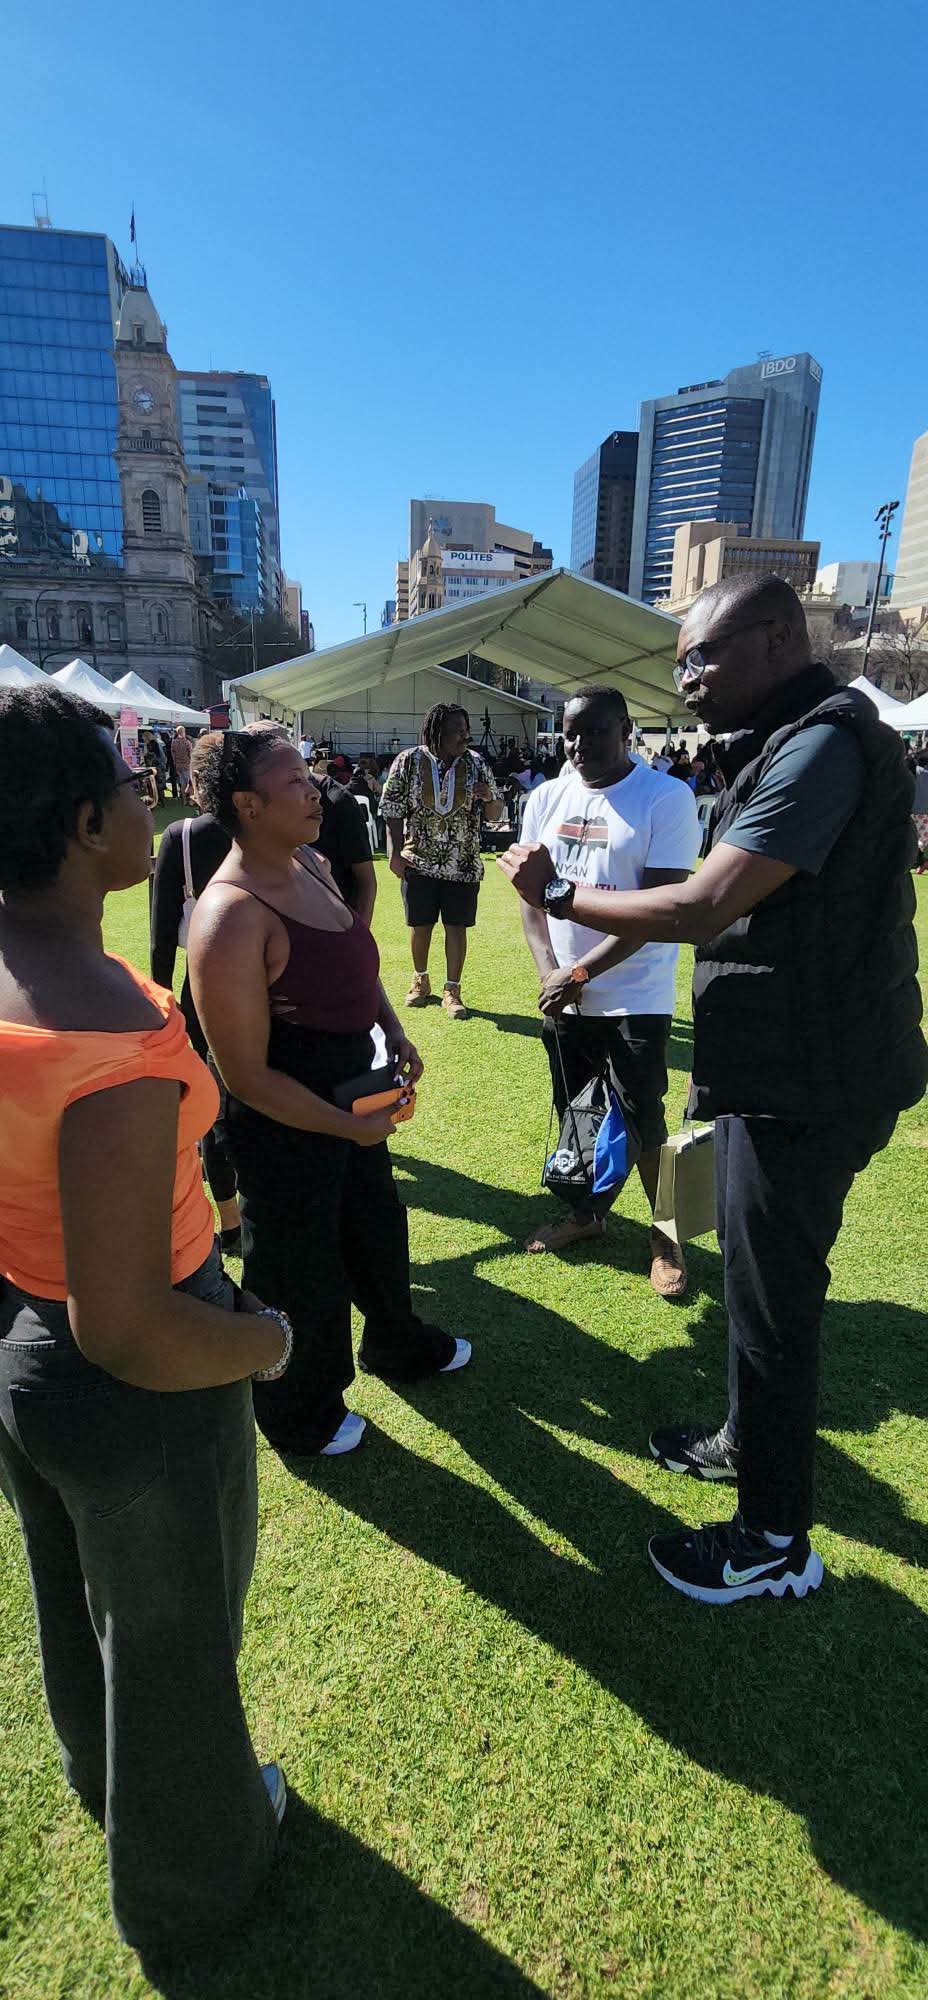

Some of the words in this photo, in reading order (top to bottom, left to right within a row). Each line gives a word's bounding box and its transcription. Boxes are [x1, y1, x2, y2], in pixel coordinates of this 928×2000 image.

[764, 357, 796, 376] BDO
[450, 552, 493, 562] POLITES
[555, 862, 588, 878] NYAN
